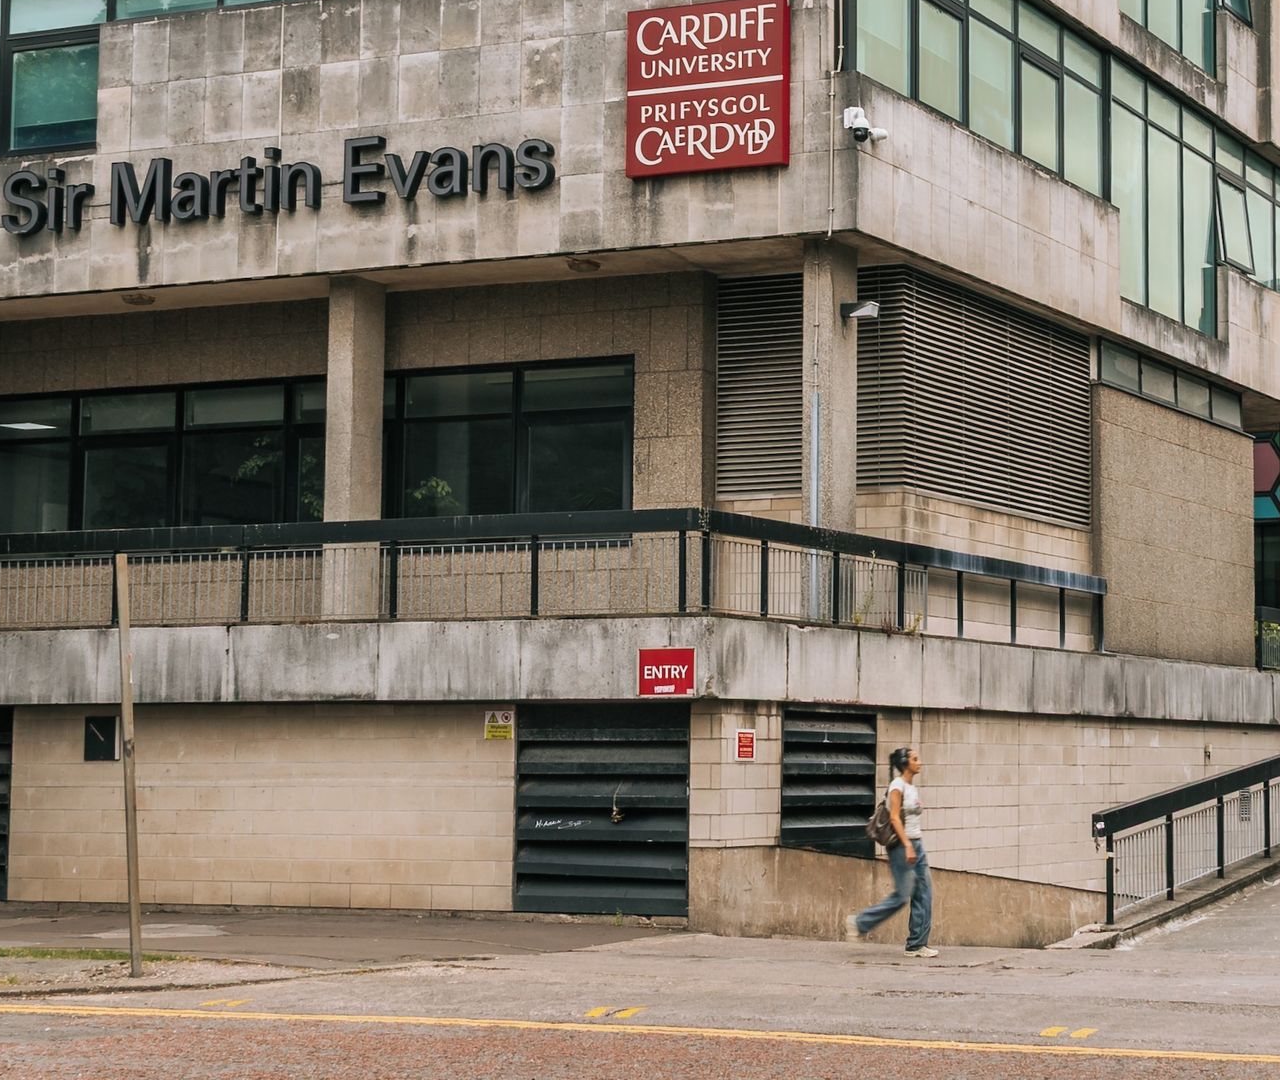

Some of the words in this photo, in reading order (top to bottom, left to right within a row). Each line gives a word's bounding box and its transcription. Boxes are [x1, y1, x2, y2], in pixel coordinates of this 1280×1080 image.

[635, 3, 777, 56] CARDIFF
[640, 47, 772, 79] UNIVERSITY
[640, 93, 771, 124] PRIFYSGOL
[634, 118, 776, 166] CAERDYDD
[1, 168, 95, 236] Sir
[109, 146, 321, 226] Martin
[342, 134, 557, 205] Evans
[644, 665, 688, 679] ENTRY
